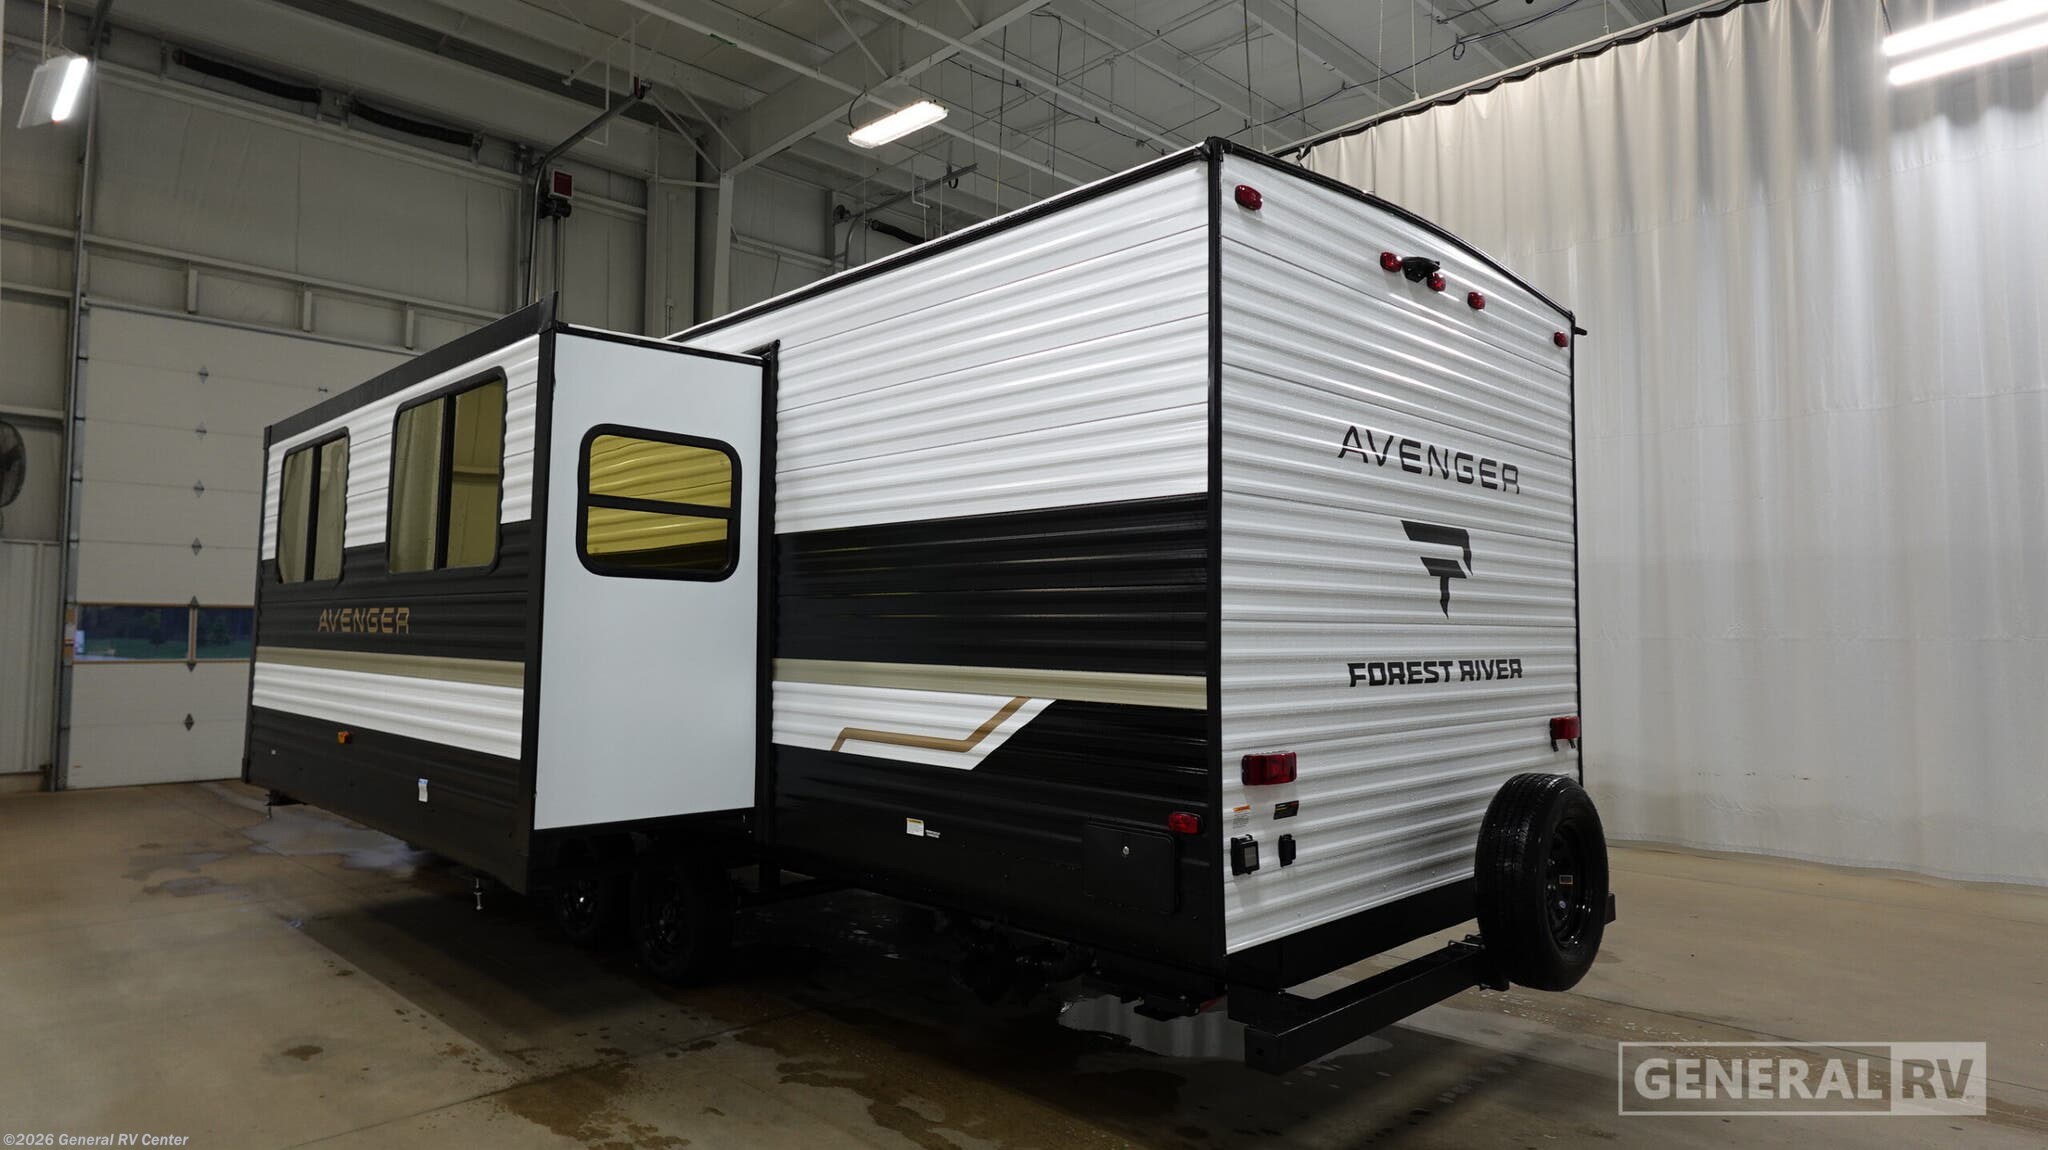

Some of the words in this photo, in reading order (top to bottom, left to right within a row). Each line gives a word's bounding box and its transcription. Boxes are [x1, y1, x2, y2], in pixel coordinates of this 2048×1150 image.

[1338, 425, 1520, 494] AVENGER
[318, 607, 410, 634] AVENGER
[1347, 660, 1453, 687] FOREST
[1458, 658, 1523, 682] RIVER
